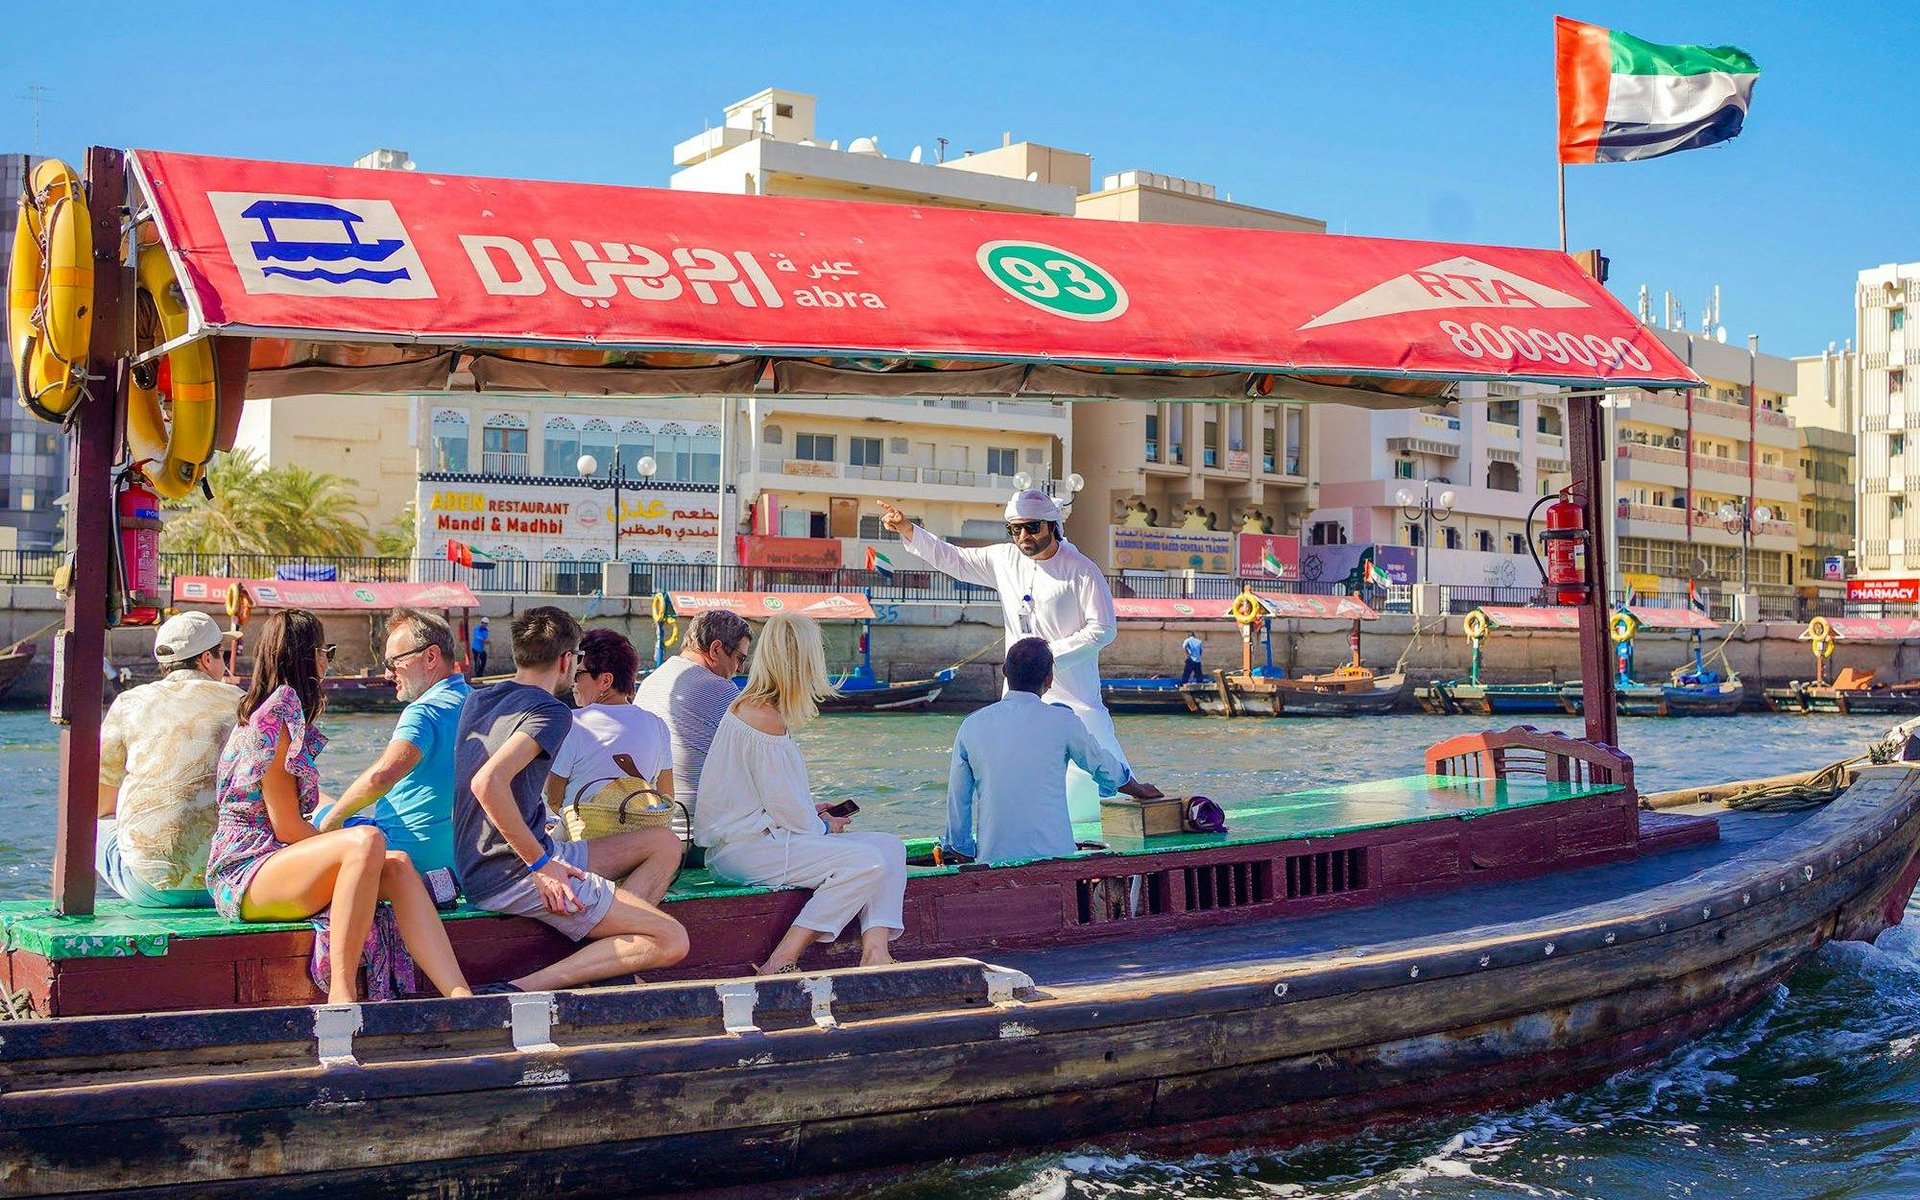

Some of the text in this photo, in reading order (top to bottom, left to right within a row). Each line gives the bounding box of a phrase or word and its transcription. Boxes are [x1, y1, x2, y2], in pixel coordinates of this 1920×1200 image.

[768, 252, 860, 280] عبرة
[1000, 256, 1106, 300] 93
[792, 285, 887, 309] abra
[1415, 271, 1547, 308] RTA
[1438, 320, 1653, 372] 8009090
[431, 491, 570, 514] ADEN RESTAURANT
[437, 515, 563, 534] Mandi & Madhbi
[1851, 588, 1914, 599] PHARMACY
[874, 604, 899, 622] 35
